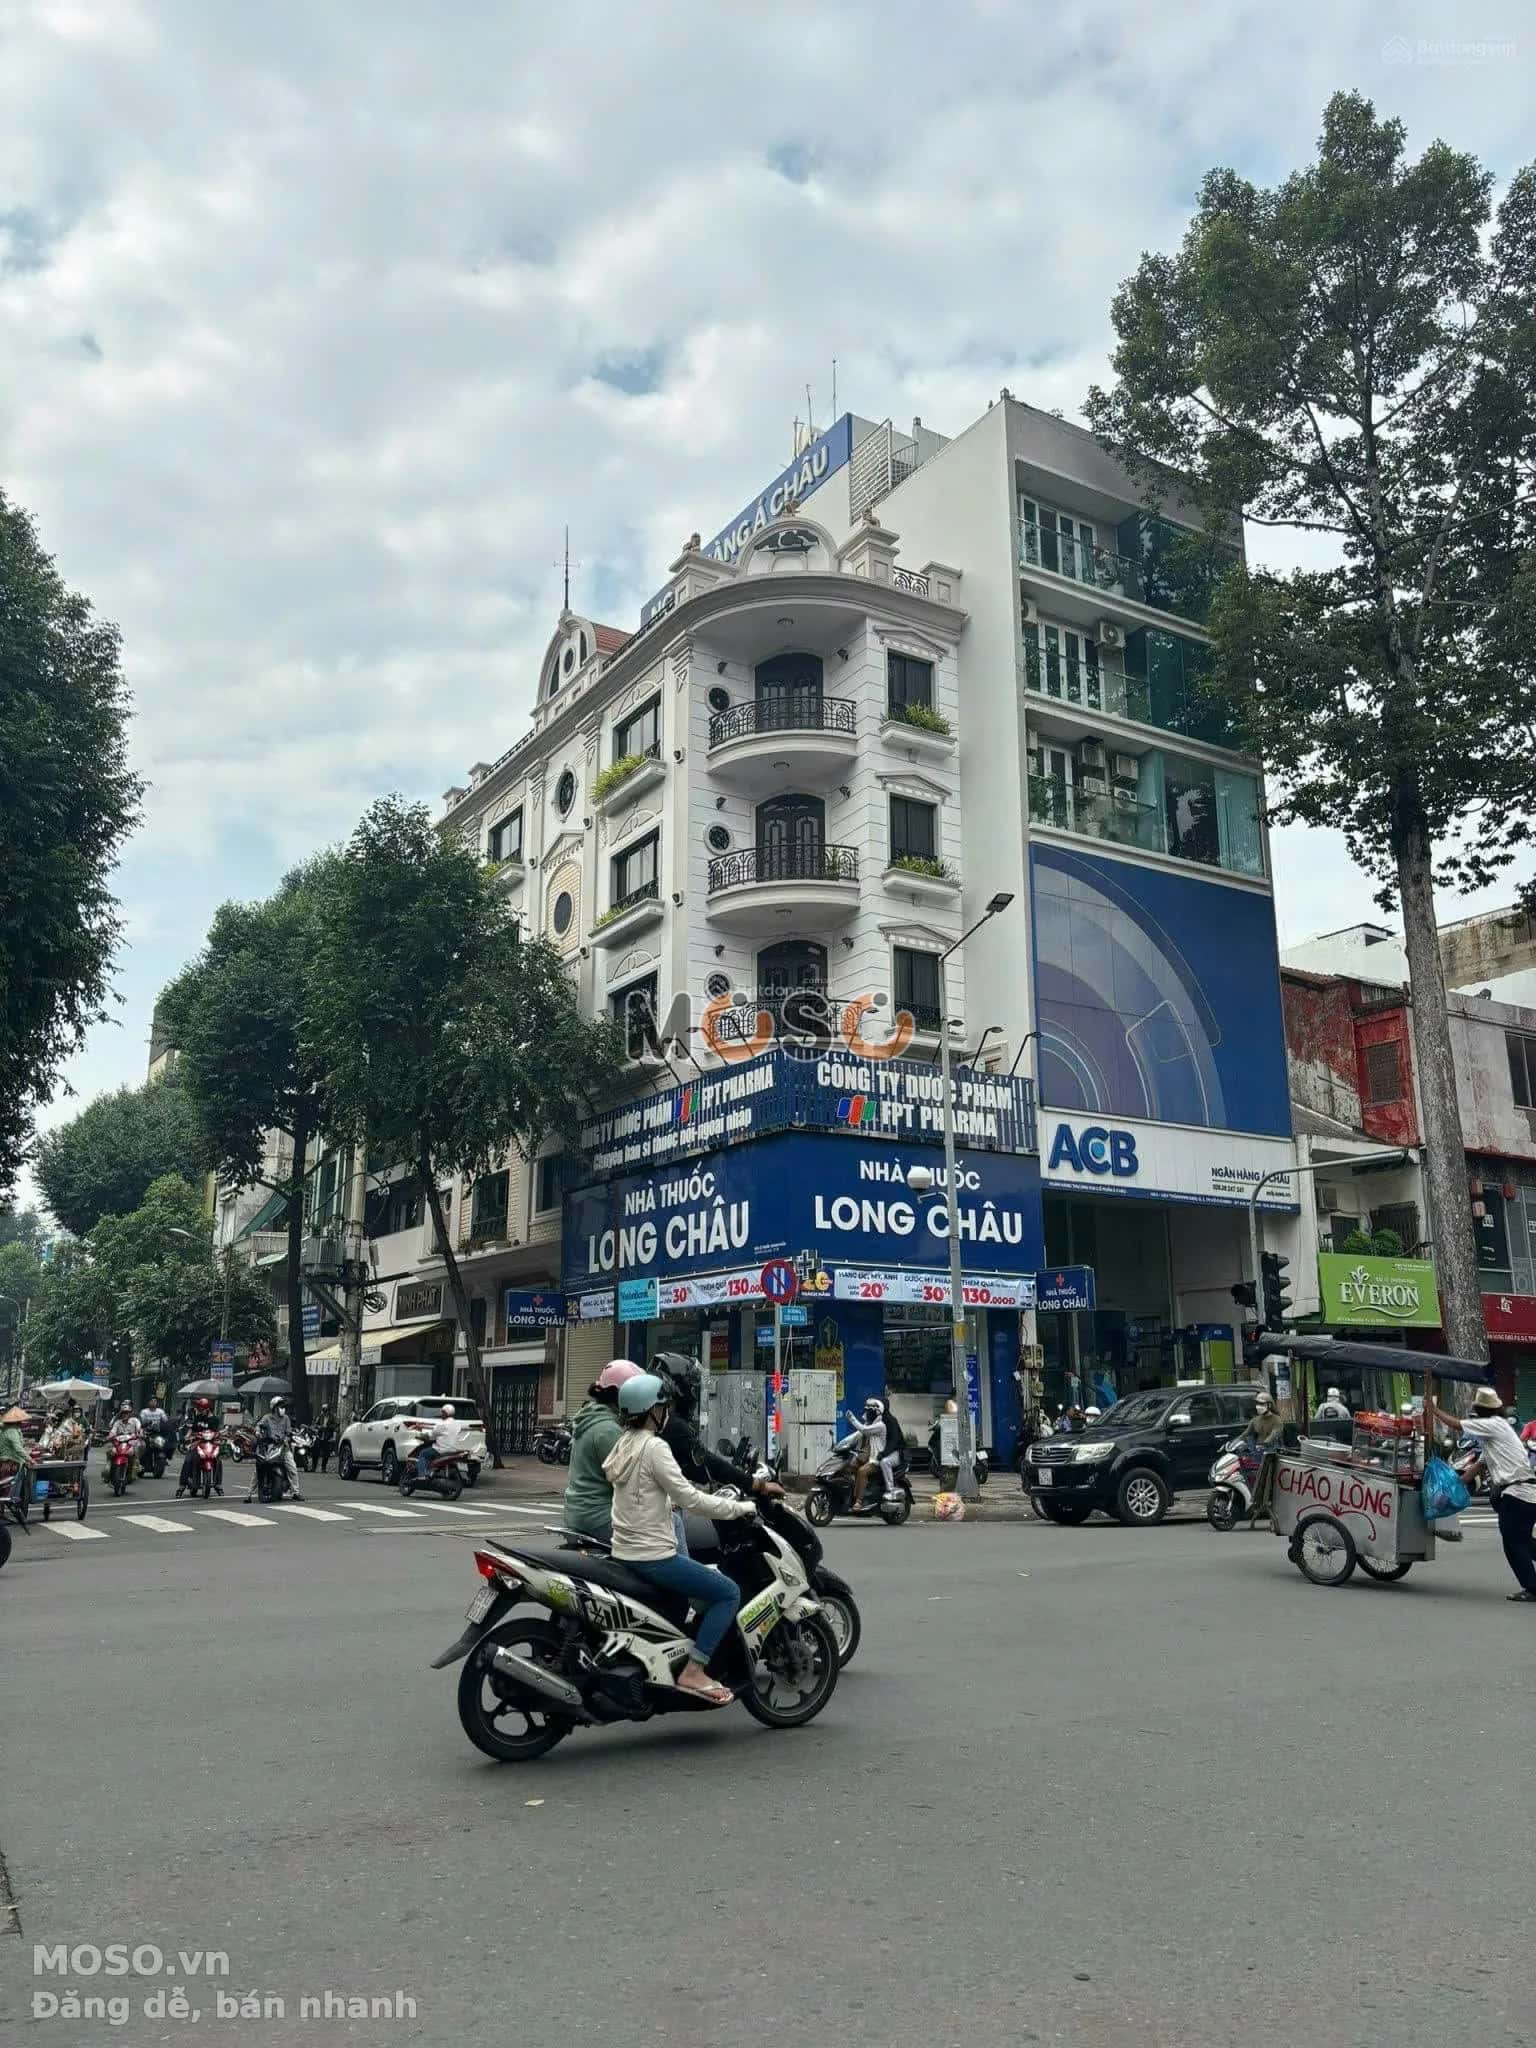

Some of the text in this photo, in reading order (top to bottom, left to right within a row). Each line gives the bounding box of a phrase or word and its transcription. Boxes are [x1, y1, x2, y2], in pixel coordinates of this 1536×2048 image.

[708, 518, 751, 563] ÀNG
[770, 445, 829, 517] CHÂU
[722, 1064, 773, 1103] PHARMA
[817, 1056, 871, 1092] CÔNG
[877, 1070, 899, 1095] TY
[882, 1101, 914, 1129] FPT
[1048, 1123, 1139, 1177] ACB
[625, 1161, 715, 1216] NHÀ THUỐC
[859, 1157, 981, 1190] NHÀ UỐC
[1211, 1166, 1236, 1178] NGÂN
[1237, 1168, 1261, 1181] HÀNG
[588, 1195, 749, 1274] LONG CHÂU
[815, 1195, 1023, 1244] LONG CHÂU
[1038, 1295, 1087, 1311] LONG CHÂU
[1340, 1282, 1420, 1307] EVERON
[509, 1314, 565, 1326] LONG CHÂU
[1278, 1466, 1392, 1518] CHÁO LÒNG
